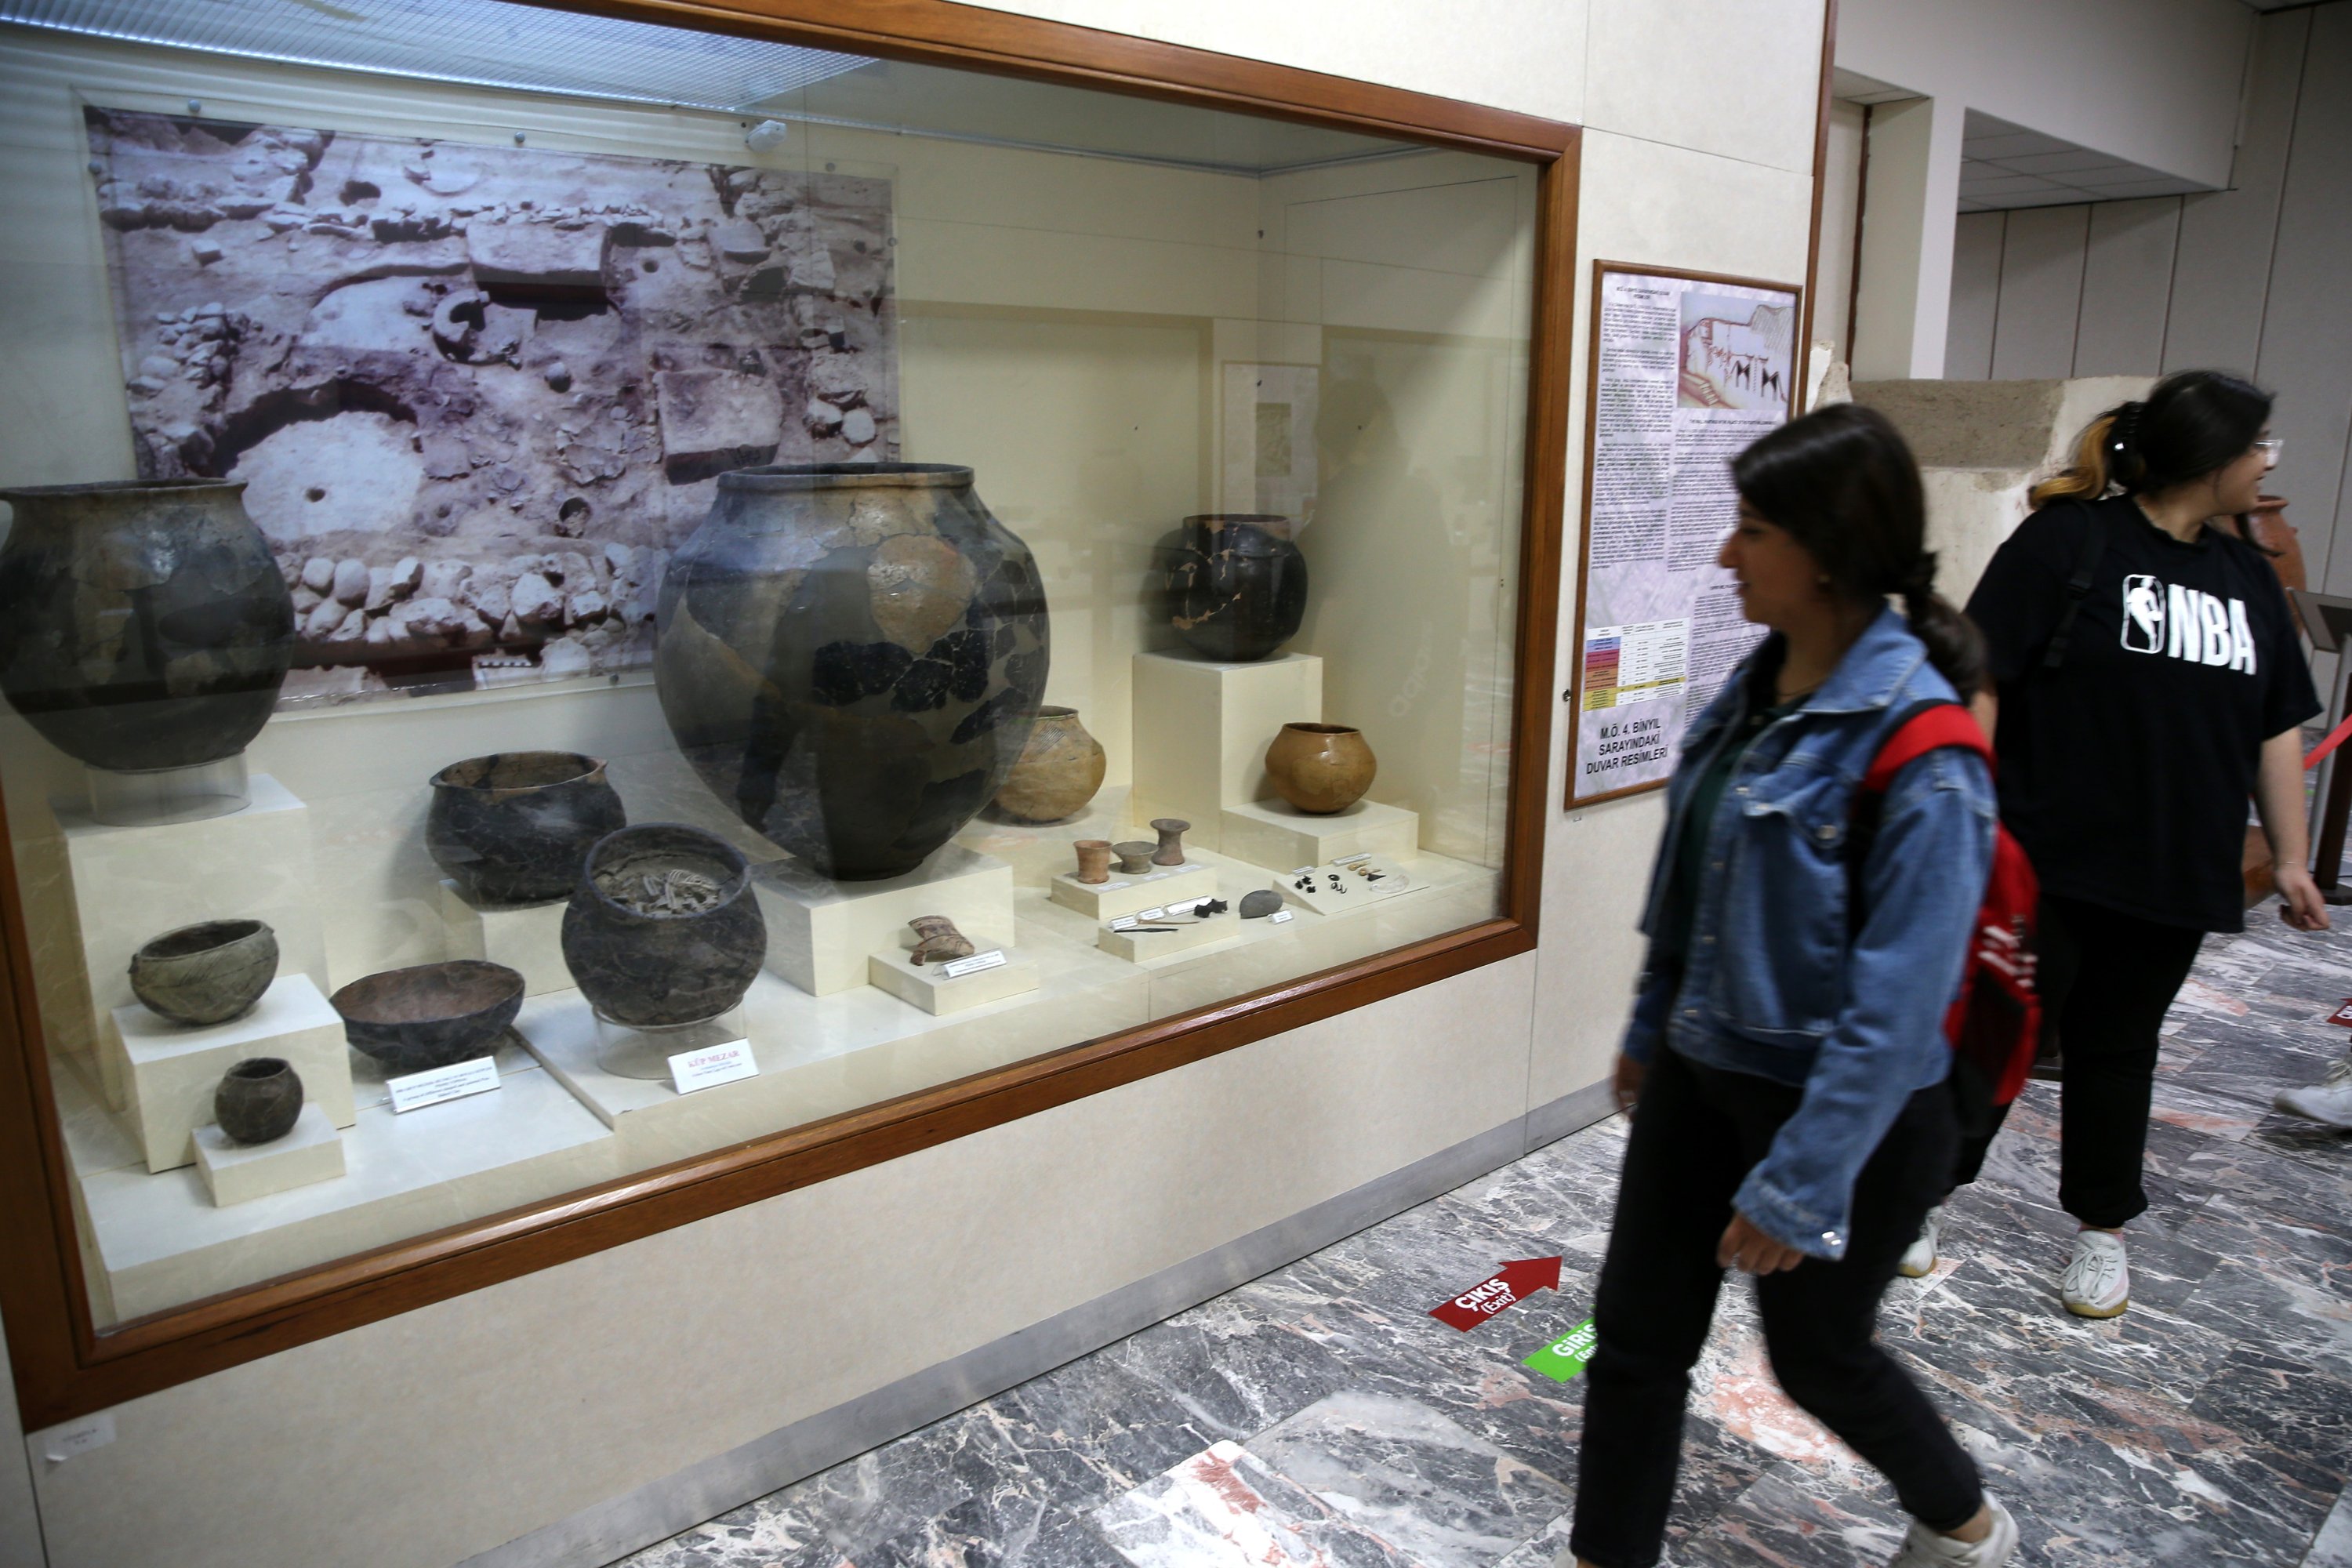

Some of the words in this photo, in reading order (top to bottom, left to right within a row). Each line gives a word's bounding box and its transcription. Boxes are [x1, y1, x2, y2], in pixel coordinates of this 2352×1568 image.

[2168, 583, 2257, 675] NBA
[1622, 724, 1630, 735] 4.
[1632, 718, 1661, 734] BİNYIL
[1599, 731, 1660, 756] SARAYINDAKİ
[1586, 757, 1619, 775] DUVAR
[1621, 744, 1668, 768] RESİMLERİ
[1454, 1278, 1512, 1312] ÇIKIŞ
[1480, 1293, 1516, 1314] (Exit)
